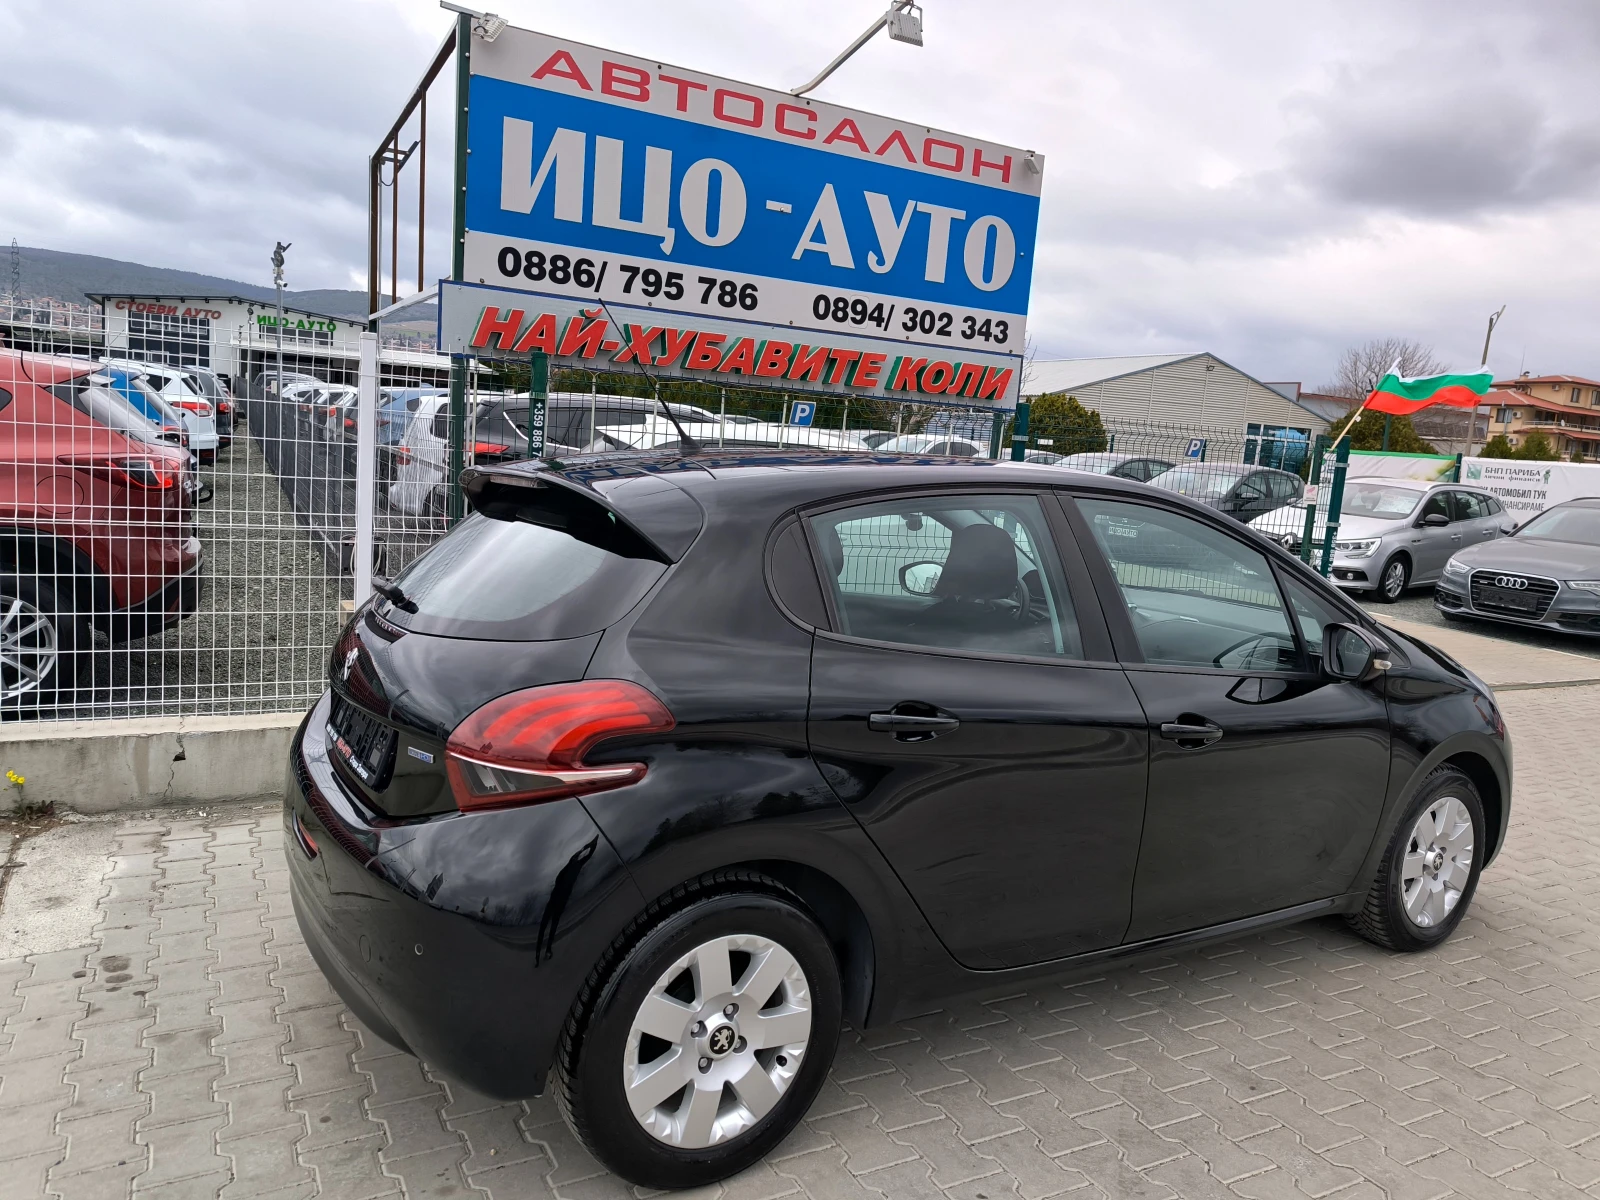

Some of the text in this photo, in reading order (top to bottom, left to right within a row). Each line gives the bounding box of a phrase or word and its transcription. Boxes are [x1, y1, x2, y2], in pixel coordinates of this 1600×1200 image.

[530, 49, 1012, 184] АВТОСАЛОН
[497, 247, 759, 311] 0886/ 795 786
[115, 301, 222, 320] СТОЕВИ АУТО
[812, 294, 1009, 344] 0894/ 302 343
[257, 314, 337, 332] ИЦО-АУТО
[469, 306, 1014, 400] НАЙ-ХУБАВИТЕ КОЛИ
[793, 406, 811, 424] P
[532, 402, 545, 460] +359 886 7
[1188, 440, 1201, 456] P
[1485, 466, 1540, 476] БНП ПАРИБА
[1533, 489, 1548, 500] ТУК
